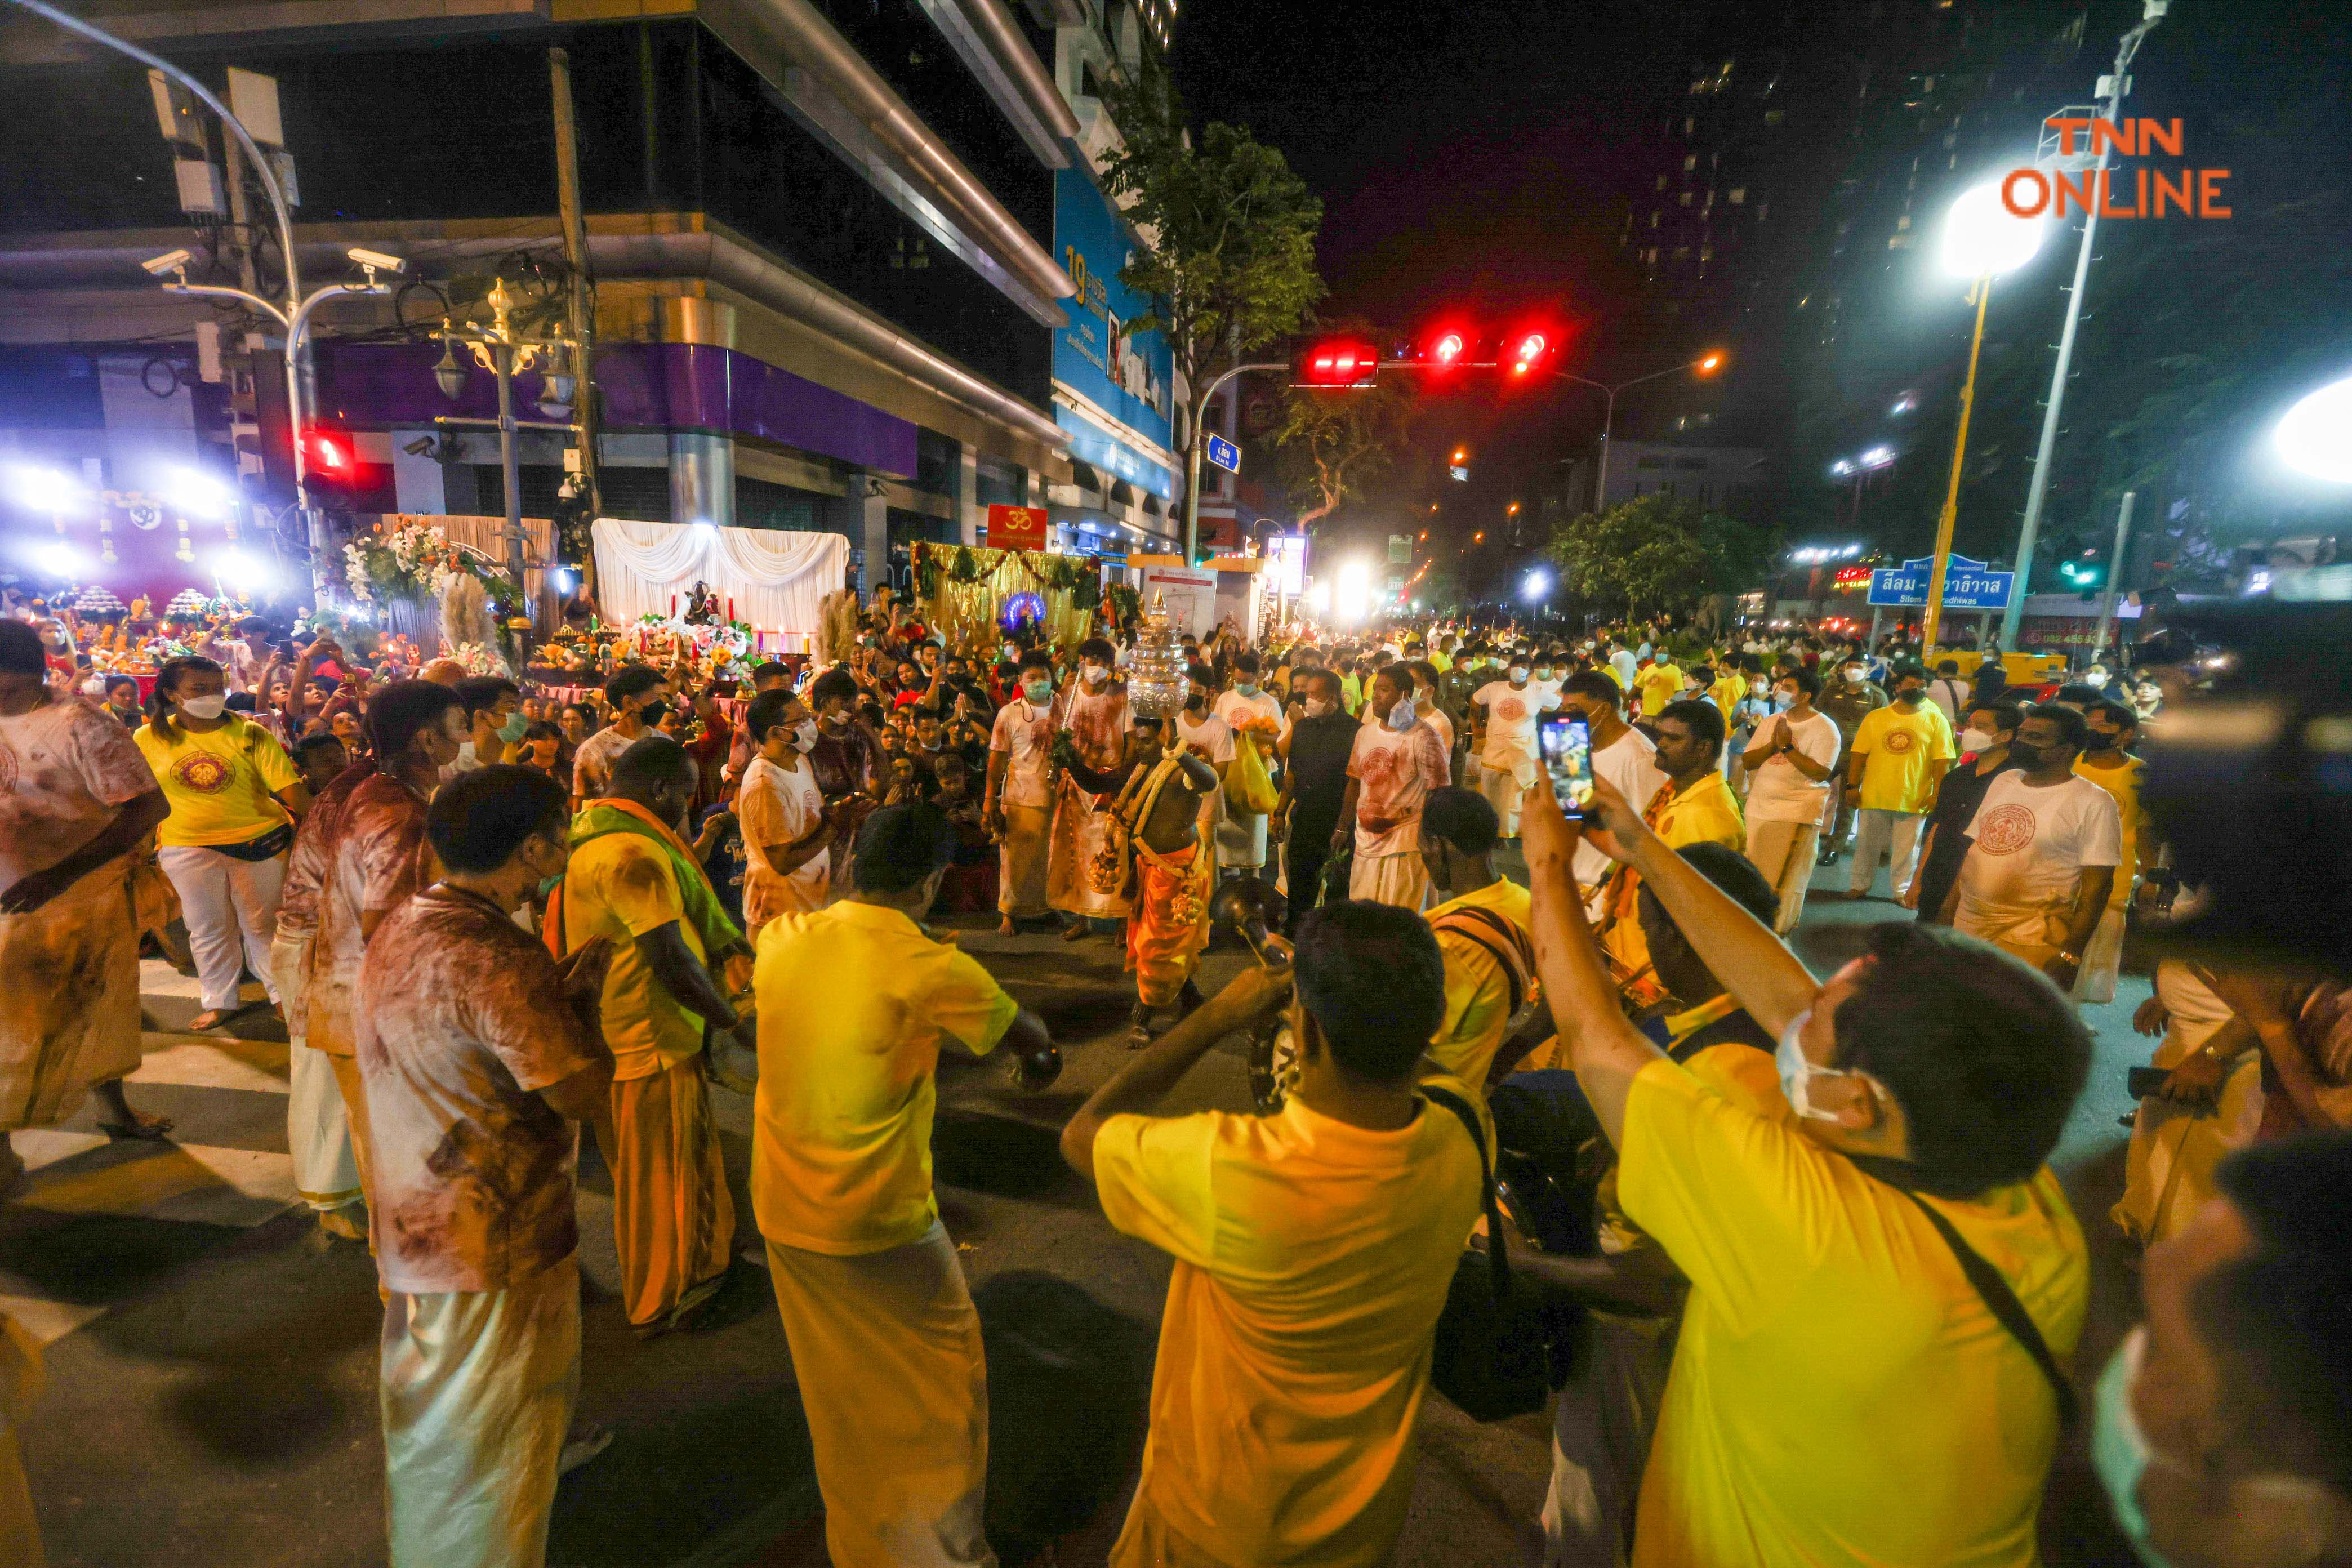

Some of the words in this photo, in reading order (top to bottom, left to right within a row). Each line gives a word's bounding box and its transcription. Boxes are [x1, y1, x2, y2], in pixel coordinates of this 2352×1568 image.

[1066, 245, 1085, 304] 19
[1883, 571, 1916, 590] สีลม
[1944, 574, 2001, 593] ราธิวาส
